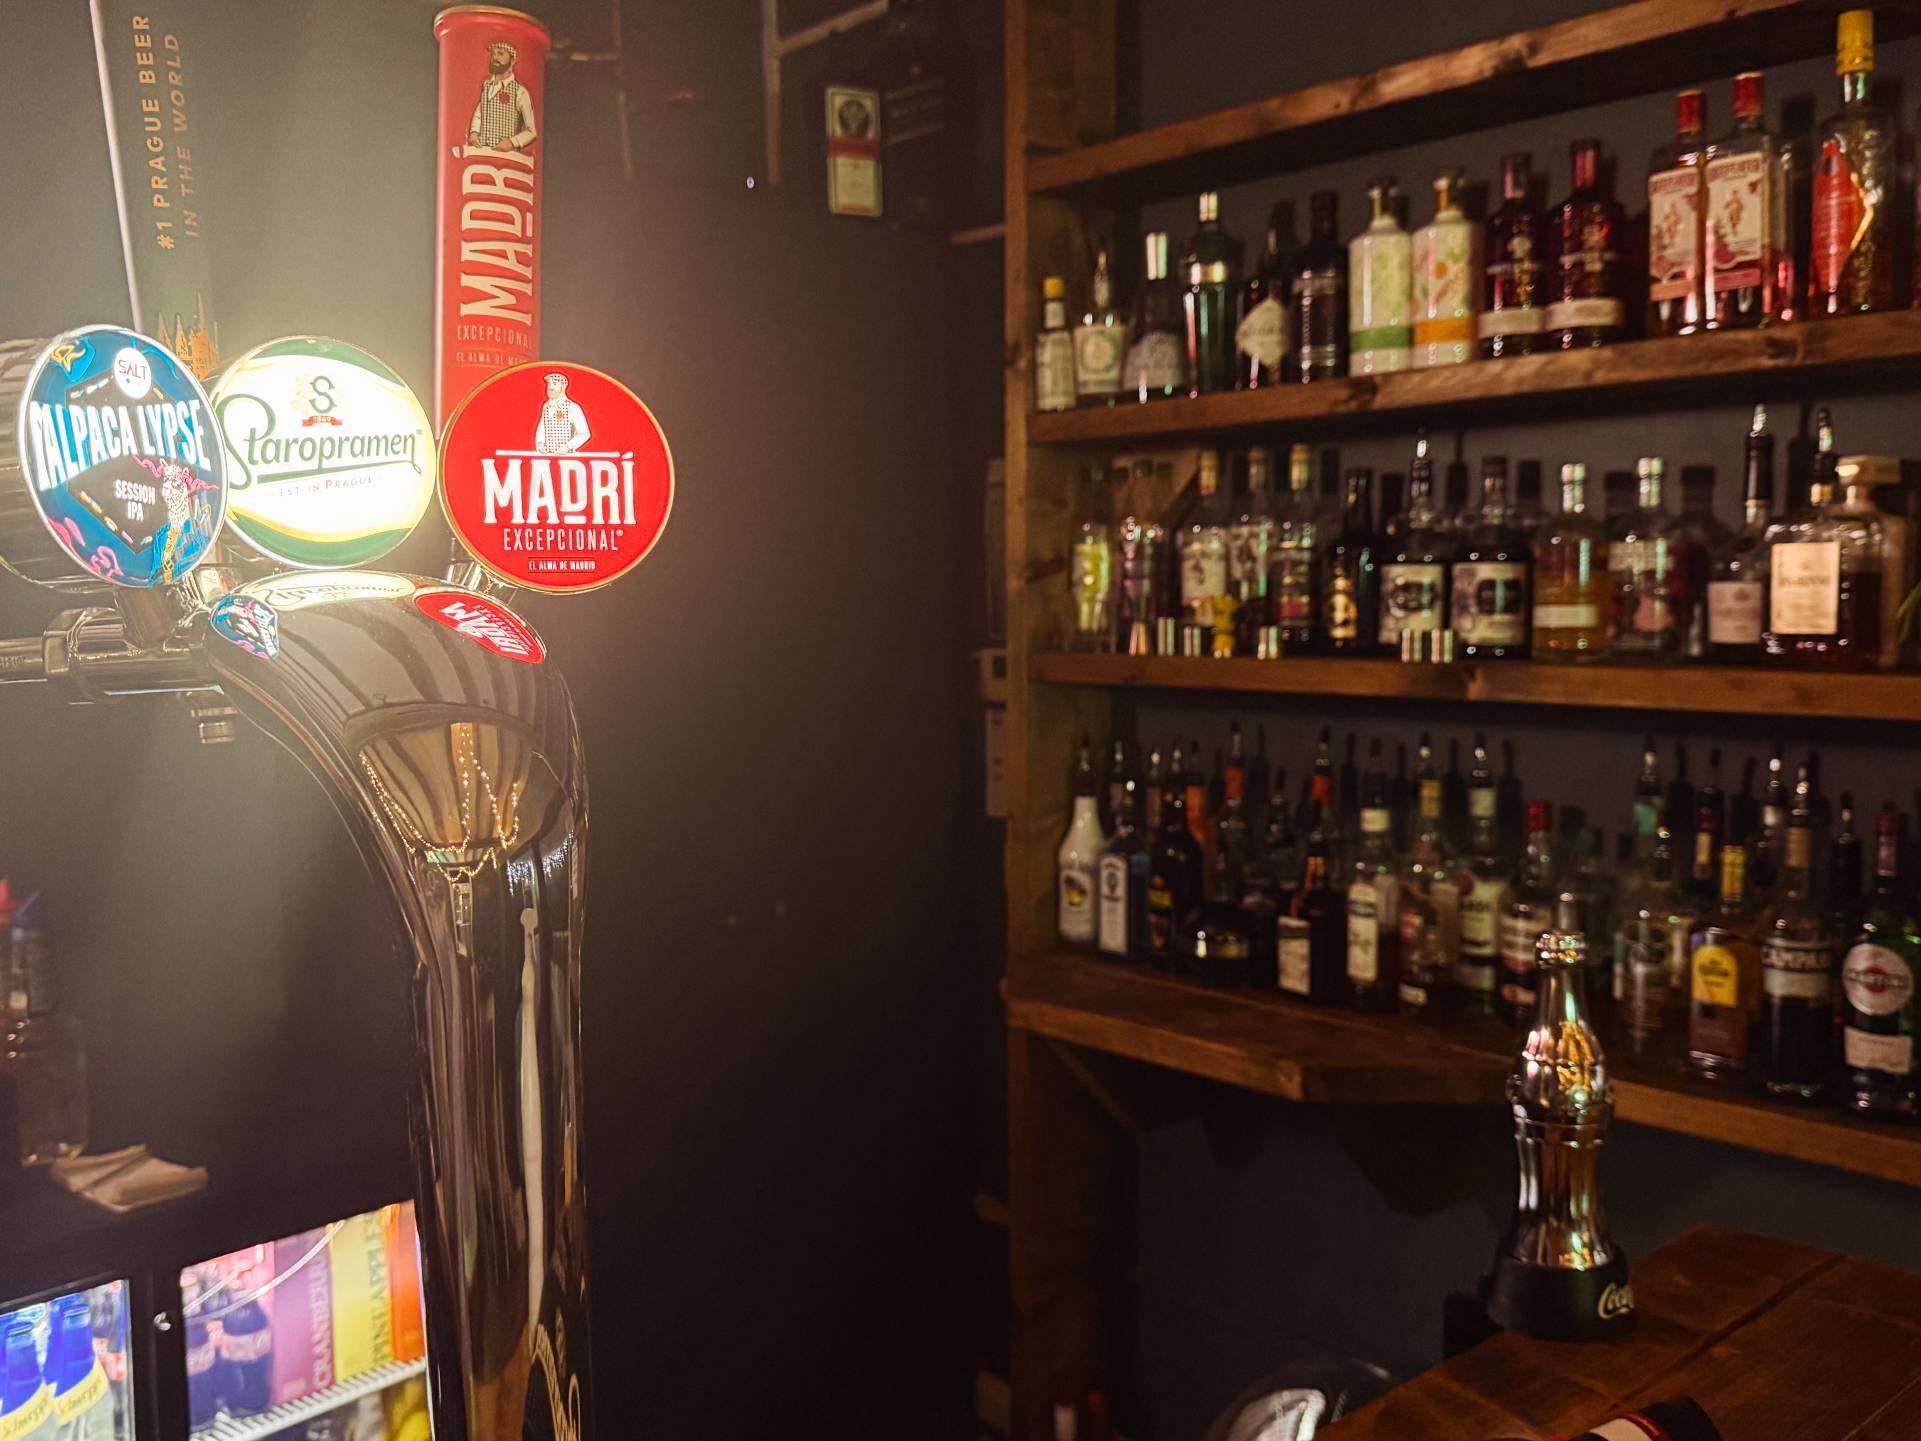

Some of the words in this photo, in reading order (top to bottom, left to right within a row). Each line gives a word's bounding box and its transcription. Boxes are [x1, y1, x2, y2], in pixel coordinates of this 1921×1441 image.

[132, 15, 157, 84] BEER
[164, 34, 188, 133] WORLD
[142, 99, 171, 209] PRAGUE
[177, 146, 194, 197] THE
[156, 220, 175, 250] #1
[184, 210, 199, 237] IN
[118, 359, 148, 381] SALT
[456, 352, 465, 362] EL
[468, 352, 491, 364] ALMA
[211, 392, 422, 491] Staropramen
[115, 479, 156, 505] SESSION
[481, 450, 637, 525] MADRÍ
[127, 501, 144, 521] IPA
[503, 528, 618, 551] EXCEPCIONAL
[528, 560, 537, 570] EL
[539, 560, 557, 570] ALMA
[560, 560, 568, 570] DE
[570, 560, 596, 570] MADRID
